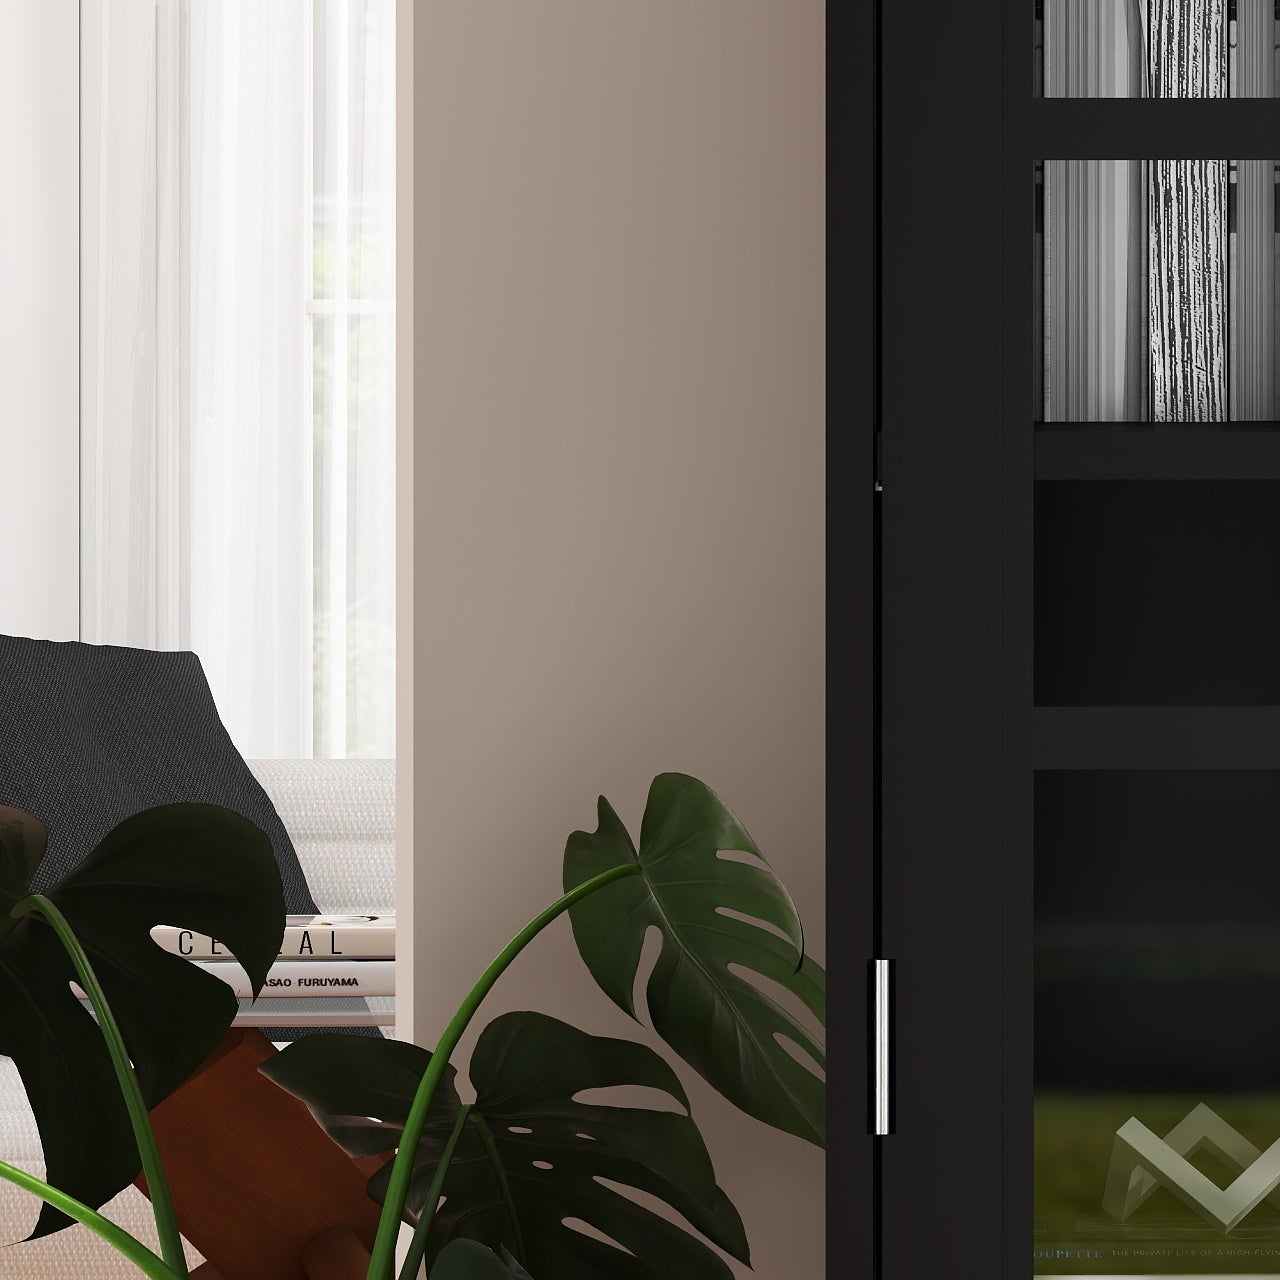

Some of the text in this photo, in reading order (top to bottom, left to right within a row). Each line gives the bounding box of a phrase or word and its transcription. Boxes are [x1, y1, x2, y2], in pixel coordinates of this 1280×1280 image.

[178, 930, 342, 955] CEAL
[298, 977, 359, 987] FURUYAMA
[1112, 1249, 1130, 1257] THE
[1133, 1249, 1172, 1257] PRIVATE
[1176, 1249, 1195, 1257] LIFE
[1199, 1249, 1213, 1257] OF
[1216, 1249, 1223, 1257] A
